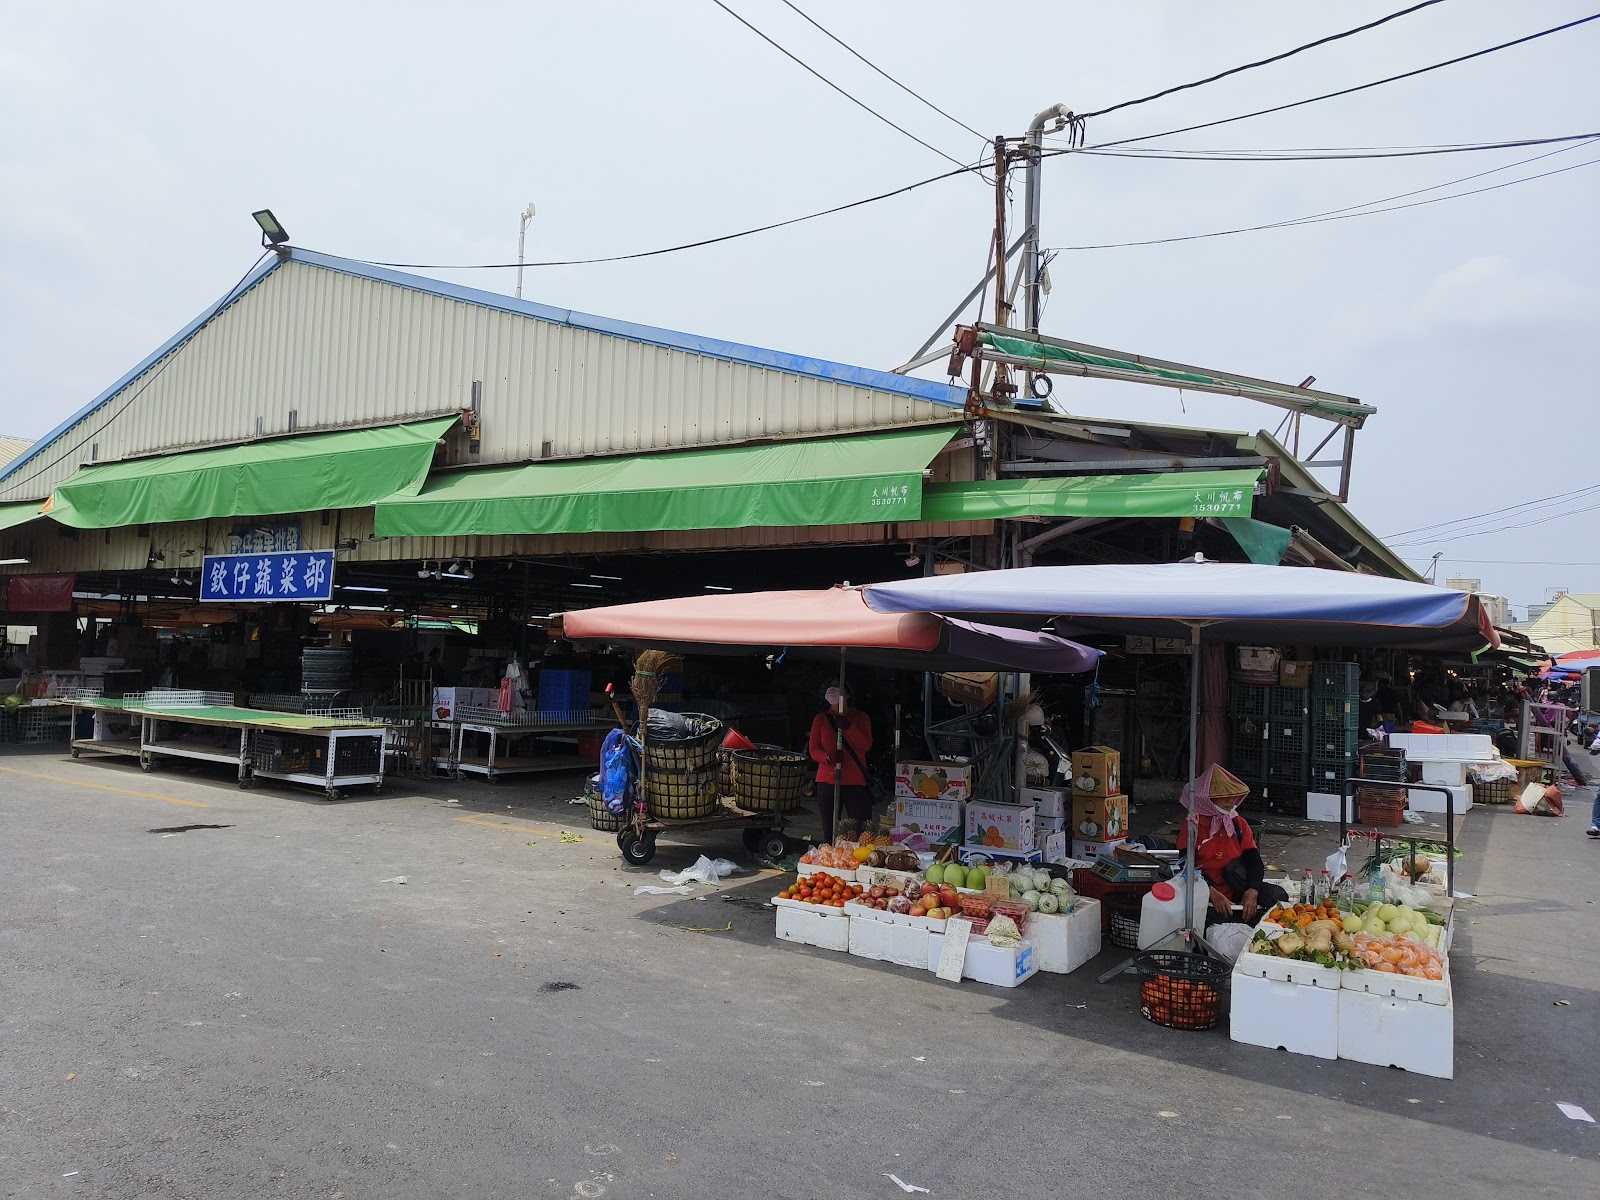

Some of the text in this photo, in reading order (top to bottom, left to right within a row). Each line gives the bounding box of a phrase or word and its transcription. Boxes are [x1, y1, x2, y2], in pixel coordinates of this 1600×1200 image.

[872, 486, 908, 498] 大川帆布
[1193, 490, 1242, 503] 大川帆布
[871, 497, 907, 506] 3530771
[1192, 503, 1241, 512] 3530771
[210, 556, 326, 596] 欽仔蔬菜部
[980, 811, 1013, 824] 高級水果
